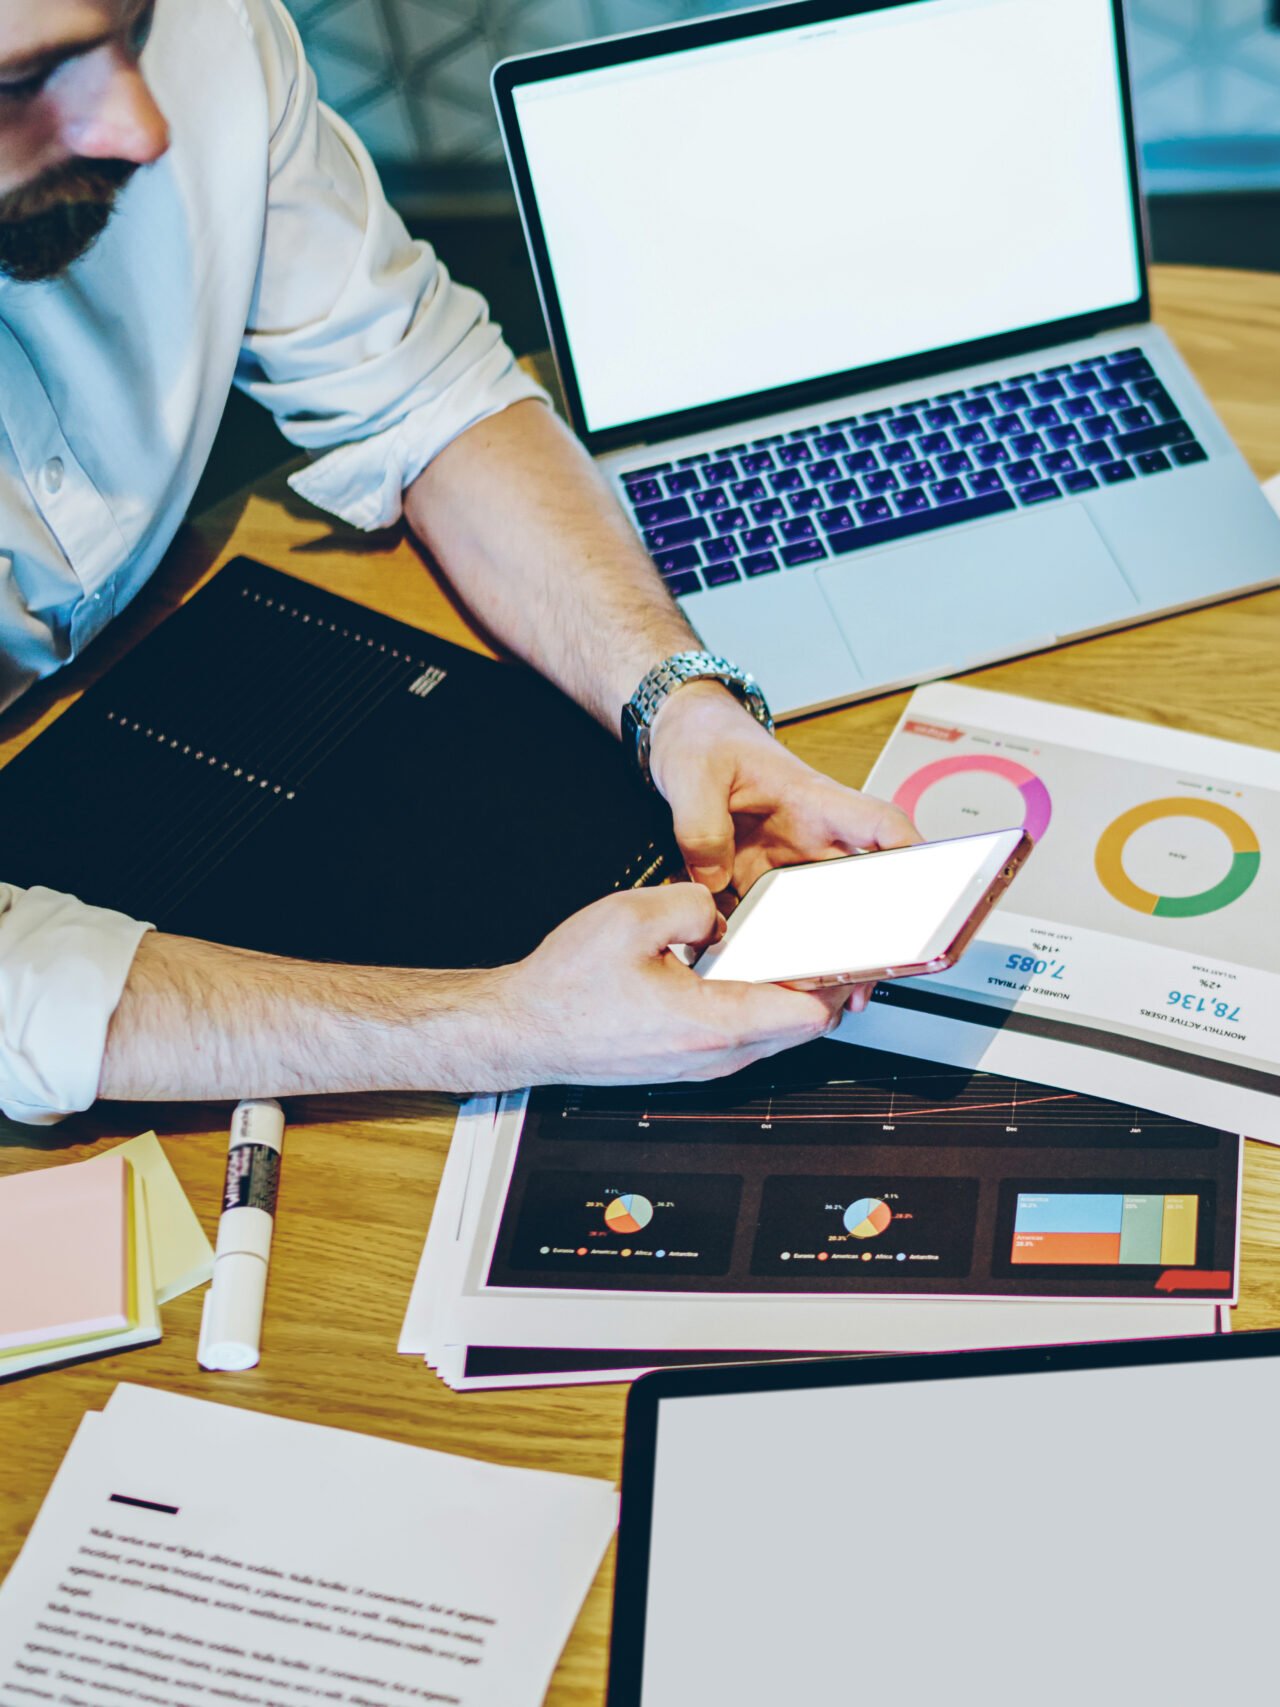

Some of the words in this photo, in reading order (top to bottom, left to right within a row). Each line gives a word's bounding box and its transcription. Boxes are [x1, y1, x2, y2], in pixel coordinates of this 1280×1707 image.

[1031, 942, 1061, 954] +14%
[1005, 953, 1067, 981] 7,085
[987, 976, 1019, 990] TRIALS
[1019, 983, 1031, 993] OF
[1199, 978, 1222, 991] +2%
[1032, 985, 1070, 1000] NUMBER
[1166, 989, 1242, 1022] 78,136
[1139, 1008, 1169, 1023] USERS
[1170, 1015, 1202, 1030] ACTIVE
[1202, 1024, 1247, 1042] MONTHLY
